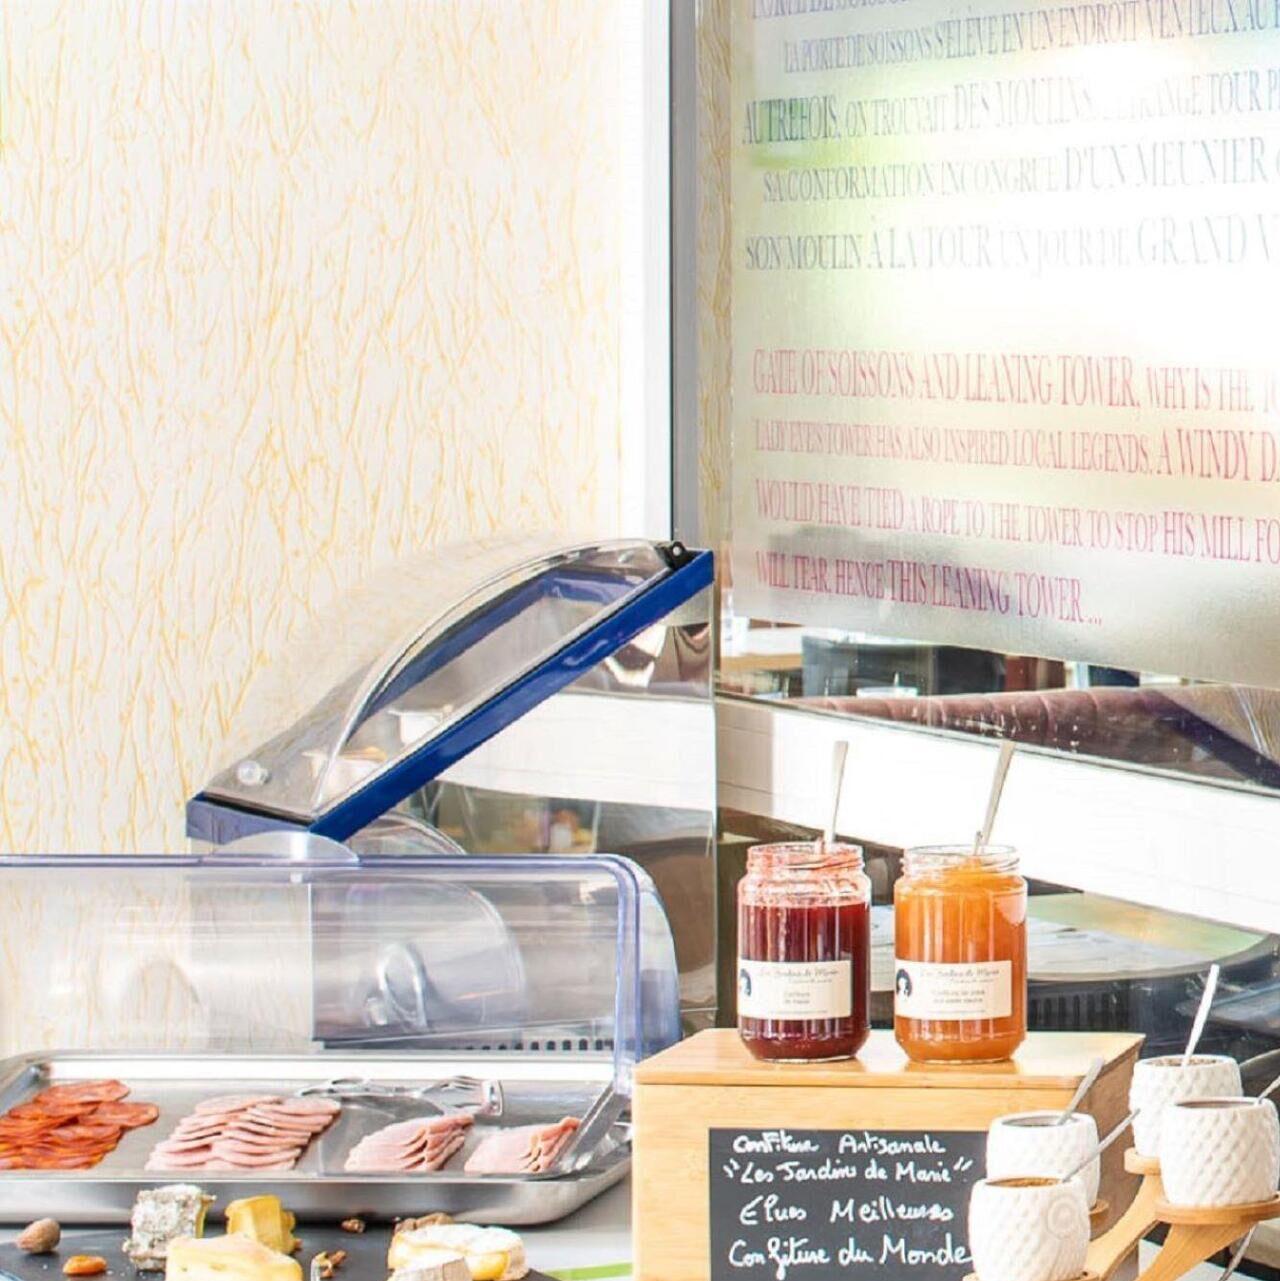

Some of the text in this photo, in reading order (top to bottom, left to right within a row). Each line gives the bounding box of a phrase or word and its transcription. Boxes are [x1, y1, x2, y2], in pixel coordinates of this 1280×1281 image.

[1136, 210, 1247, 265] GRAND
[963, 353, 1054, 405] LEANING
[1176, 427, 1253, 482] WINDY
[1198, 514, 1250, 563] MILL
[888, 558, 928, 606] THIS
[838, 1132, 946, 1155] Artisanale
[865, 1160, 887, 1181] de
[839, 1238, 875, 1266] du
[879, 1232, 975, 1266] Monde
